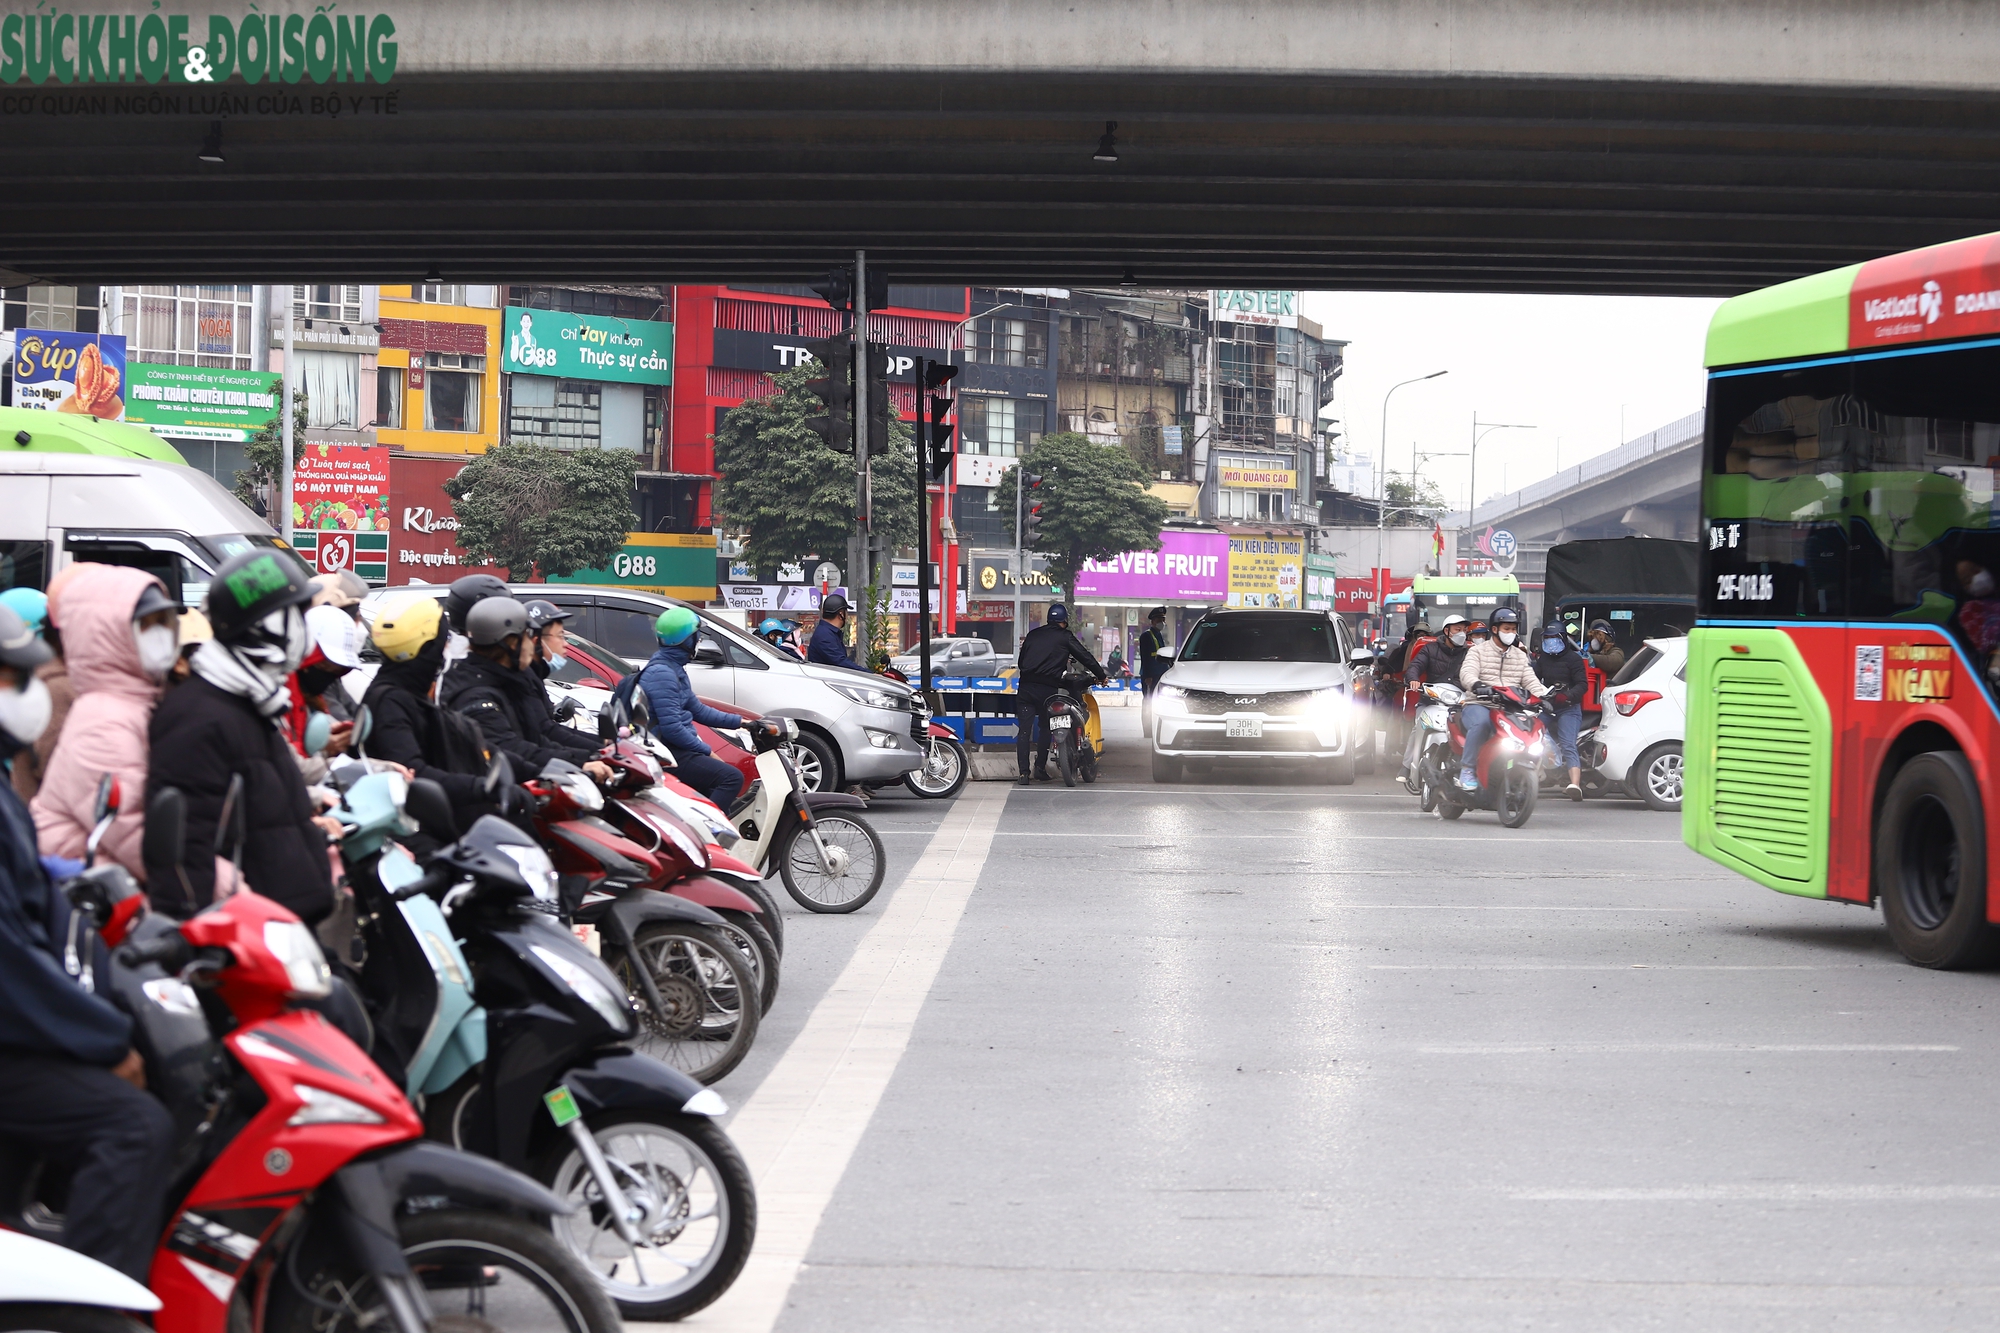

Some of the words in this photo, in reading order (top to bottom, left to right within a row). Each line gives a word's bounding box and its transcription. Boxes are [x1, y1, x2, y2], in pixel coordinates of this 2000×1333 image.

[1218, 290, 1294, 315] FASTER
[1864, 293, 1919, 322] Vietlott
[1235, 313, 1280, 325] www.faster.vn
[200, 319, 233, 338] YOGA
[561, 327, 578, 341] Chỉ
[579, 325, 608, 346] Vay
[610, 333, 623, 345] khi
[624, 333, 643, 348] bạn
[304, 331, 319, 343] PHÂN
[319, 330, 331, 344] PHỐI
[331, 331, 338, 344] VÀ
[350, 331, 356, 345] LẺ
[356, 333, 368, 346] TRÁI
[368, 334, 379, 347] CÂY
[17, 339, 77, 380] Súp
[518, 344, 557, 368] F88
[579, 347, 615, 369] Thực
[619, 353, 637, 372] sự
[639, 349, 668, 371] cần
[773, 345, 814, 367] TR
[147, 370, 168, 381] CÔNG
[168, 373, 177, 381] TY
[176, 373, 193, 382] TNHH
[192, 373, 208, 382] THIẾT
[207, 375, 213, 383] BỊ
[218, 375, 226, 383] TẾ
[226, 376, 249, 387] NGUYỆT
[249, 377, 261, 386] CÁT
[42, 388, 62, 402] Ngư
[132, 382, 163, 401] PHÒNG
[163, 384, 189, 402] KHÁM
[190, 387, 224, 404] CHUYÊN
[224, 390, 247, 407] KHOA
[247, 392, 274, 412] NGOẠI
[206, 406, 215, 414] HÀ
[214, 407, 231, 416] MẠNH
[230, 407, 249, 416] CƯỜNG
[311, 458, 333, 470] Luôn
[334, 459, 351, 469] tươi
[352, 460, 371, 472] sạch
[297, 467, 320, 479] THỐNG
[320, 472, 335, 480] HOA
[335, 471, 350, 480] QUẢ
[350, 472, 368, 482] NHẬP
[368, 471, 386, 481] KHẨU
[1242, 468, 1271, 483] QUẢNG
[1272, 470, 1289, 484] CÁO
[294, 480, 308, 492] SỐ
[310, 483, 332, 495] MỘT
[333, 483, 355, 495] VIỆT
[356, 485, 379, 494] NAM
[1228, 539, 1244, 556] PHỤ
[1245, 537, 1262, 556] KIỆN
[1263, 539, 1280, 557] ĐIỆN
[1281, 541, 1301, 558] THOẠI
[399, 549, 422, 567] Độc
[422, 548, 457, 567] quyền
[614, 553, 657, 578] F88
[1083, 552, 1159, 575] KLEVER
[1164, 553, 1219, 577] FRUIT
[894, 571, 916, 580] ASUS
[1280, 575, 1288, 585] GIÁ
[1289, 574, 1297, 585] RẺ
[728, 597, 761, 608] Reno13
[762, 597, 769, 608] F
[893, 600, 905, 609] 24
[1887, 668, 1951, 704] NGAY
[1236, 720, 1252, 728] 30H
[1230, 729, 1259, 737] 881.54
